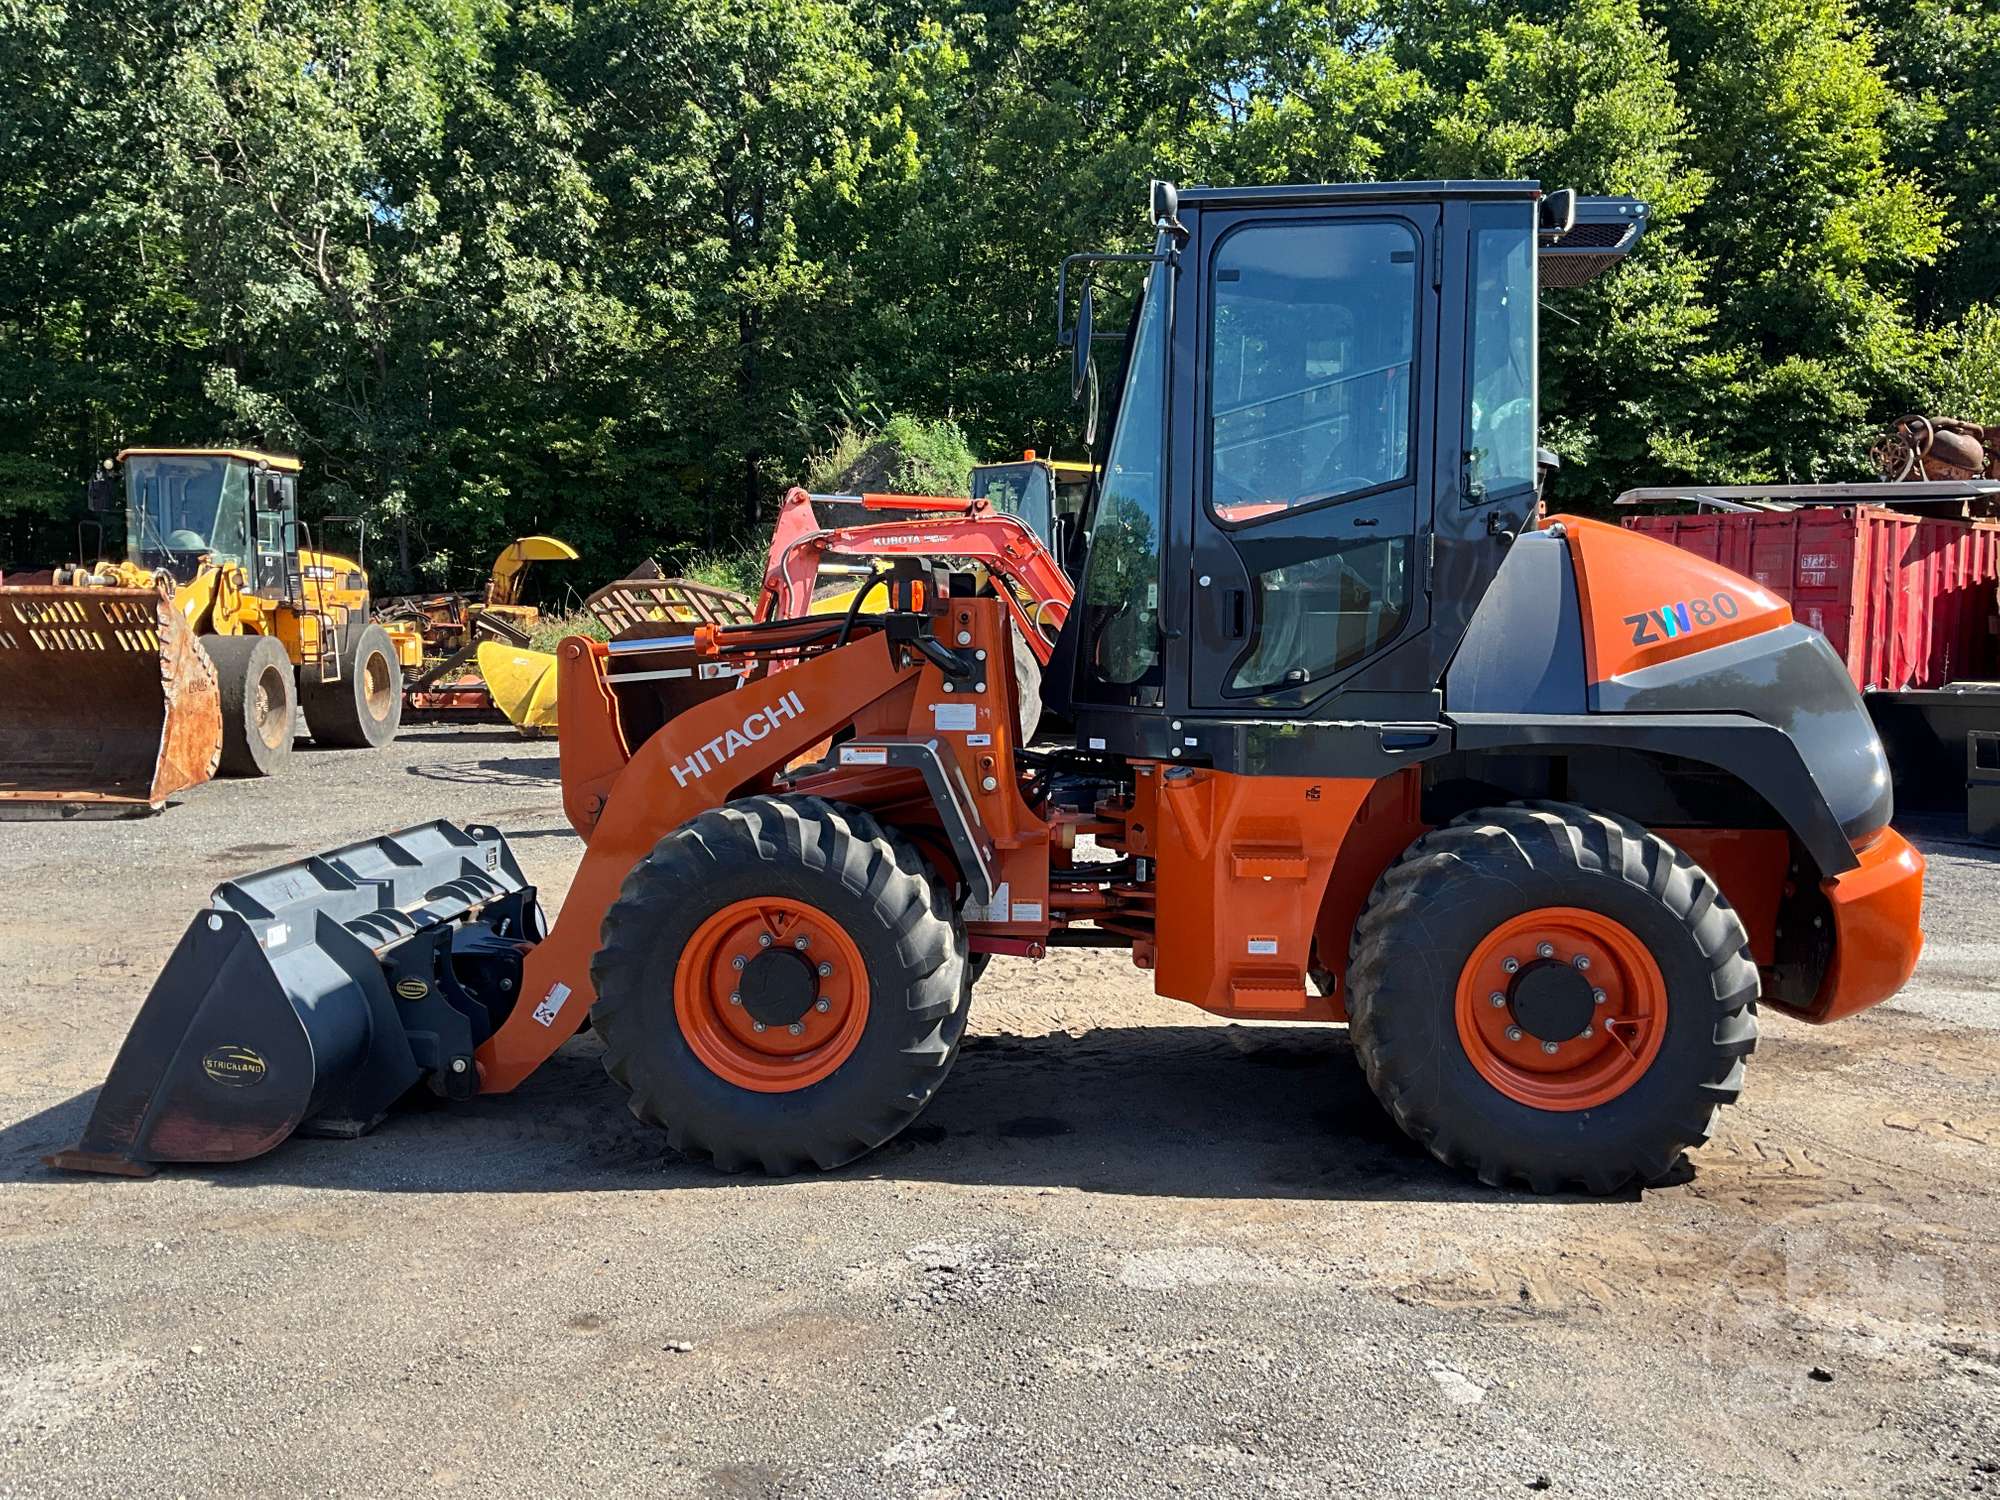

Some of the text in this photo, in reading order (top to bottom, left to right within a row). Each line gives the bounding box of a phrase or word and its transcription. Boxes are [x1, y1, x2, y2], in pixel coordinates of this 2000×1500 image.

[873, 535, 920, 546] KUBOTA
[1622, 591, 1738, 647] ZW80
[669, 690, 805, 788] HITACHI
[206, 1060, 261, 1073] STRICKLAND
